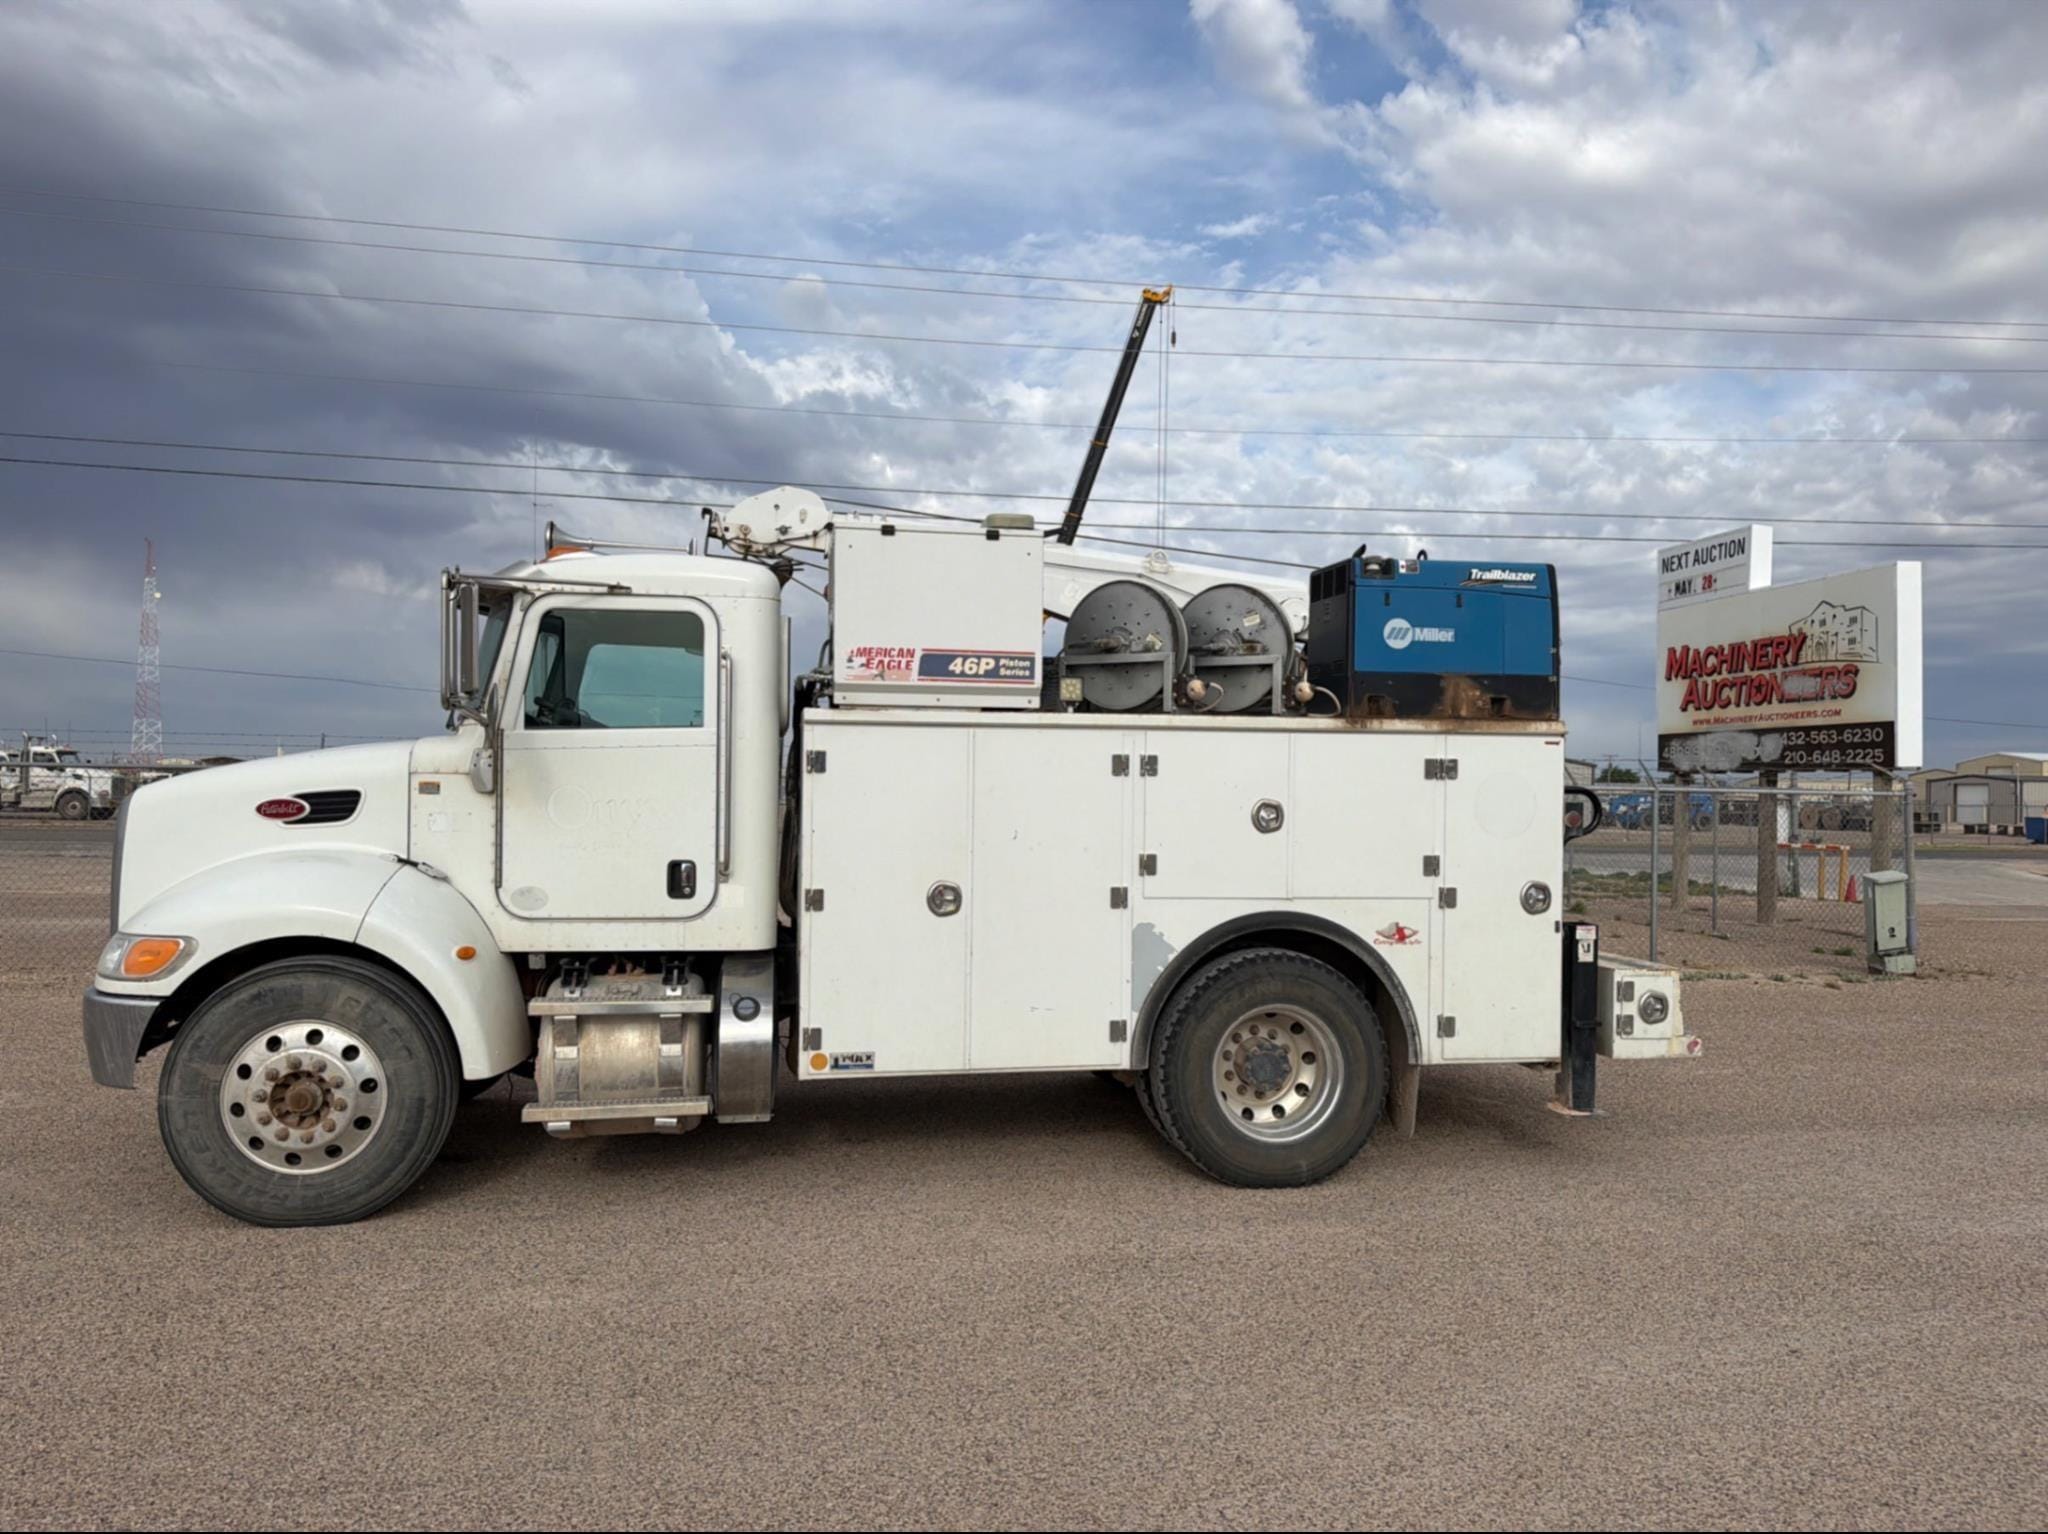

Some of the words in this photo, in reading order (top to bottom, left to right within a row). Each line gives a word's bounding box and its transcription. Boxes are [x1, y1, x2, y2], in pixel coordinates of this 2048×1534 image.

[1662, 551, 1690, 574] NEXT
[1692, 537, 1746, 567] AUCTION
[1470, 568, 1537, 582] Trailblazer
[1413, 626, 1456, 643] Miller
[848, 647, 916, 660] MERICAN
[1665, 631, 1807, 681] MACHINERY
[865, 658, 914, 671] EAGLE
[947, 656, 996, 676] 46P
[999, 658, 1031, 668] Piston
[999, 667, 1031, 677] Series
[1783, 748, 1885, 765] 210-648-2225
